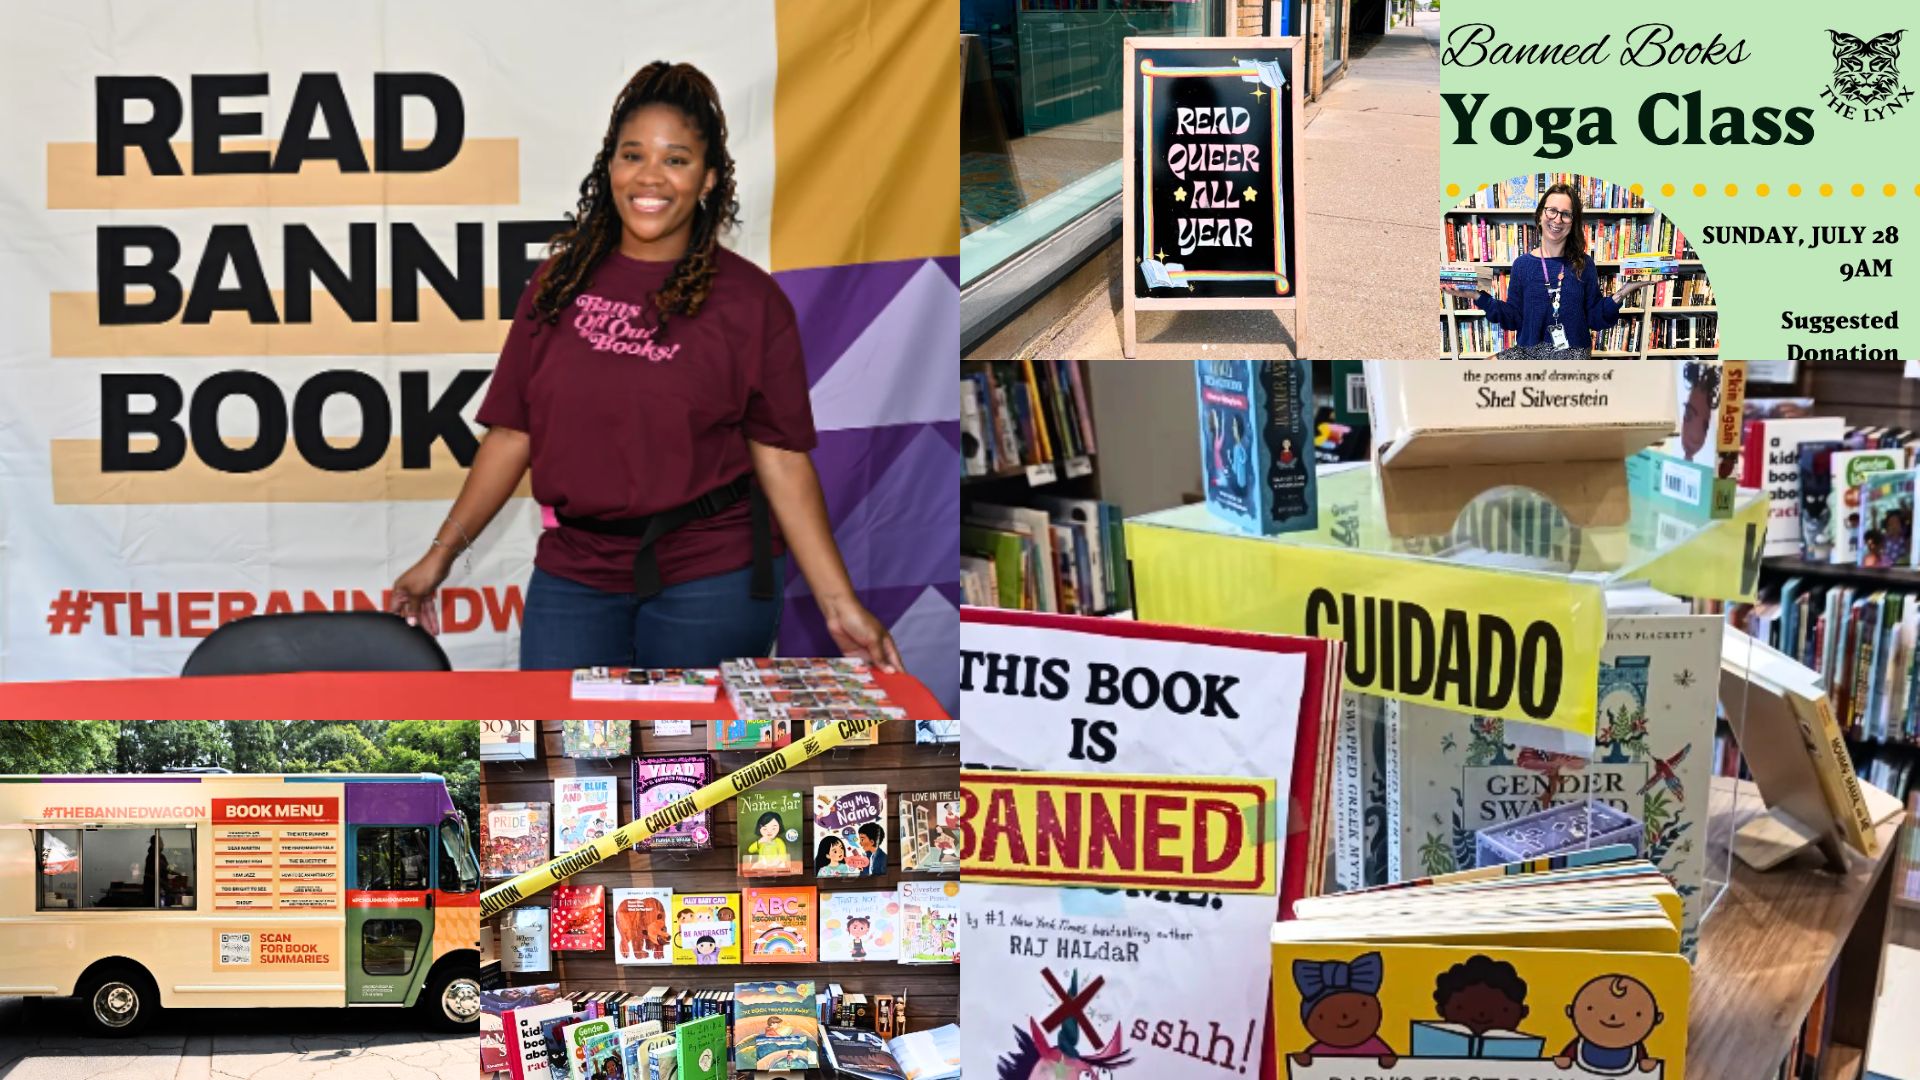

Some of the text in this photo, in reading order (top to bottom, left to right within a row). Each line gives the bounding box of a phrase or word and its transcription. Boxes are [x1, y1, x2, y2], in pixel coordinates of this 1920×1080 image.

[1441, 23, 1752, 67] Banned Books
[1820, 85, 1915, 122] THE LYNX
[95, 71, 466, 176] READ
[1175, 107, 1251, 135] READ
[1440, 90, 1815, 159] Yoga Class
[1167, 143, 1260, 179] QUEER
[1190, 180, 1240, 209] ALL
[1177, 218, 1253, 255] YEAR
[1702, 226, 1899, 249] SUNDAY, JULY 28
[97, 220, 573, 326] BANNE
[1840, 259, 1893, 283] 9AM
[1781, 311, 1899, 333] Suggested
[589, 333, 681, 361] Books!
[1787, 344, 1898, 360] Donation
[1464, 369, 1615, 383] the poems and drawings of
[1476, 386, 1609, 409] Shel Silverstein
[1722, 369, 1742, 445] Skin Again
[100, 369, 496, 473] BOOK
[1770, 437, 1780, 447] a
[1635, 631, 1693, 640] PLACKETT
[1305, 587, 1563, 720] CUIDADO
[960, 650, 1240, 719] THIS BOOK
[1068, 718, 1118, 763] IS
[649, 763, 695, 777] VLAD
[585, 782, 608, 791] BLUE
[1486, 772, 1625, 796] GENDER
[562, 793, 582, 802] AND
[741, 797, 800, 813] Name Jar
[836, 794, 871, 811] Say My
[911, 793, 928, 801] LOVE
[930, 792, 938, 800] IN
[939, 791, 952, 800] THE
[42, 805, 206, 818] #THEBANNEDWAGON
[226, 804, 323, 817] BOOK MENU
[493, 815, 527, 828] PRIDE
[550, 845, 602, 880] CUIDADO
[645, 796, 699, 834] CAUTION
[732, 752, 788, 792] CUIDADO
[837, 806, 877, 825] Name
[1347, 784, 1359, 839] GREEK
[752, 896, 798, 916] ABC
[260, 933, 292, 943] SCAN
[985, 909, 1006, 927] #1
[1010, 914, 1033, 927] New
[1036, 916, 1056, 931] York
[1058, 918, 1087, 935] Times
[1092, 923, 1151, 944] bestselling
[1156, 926, 1194, 941] author
[260, 944, 318, 953] FOR BOOK
[260, 954, 330, 964] SUMMARIES
[1010, 935, 1140, 962] RAJ HALdaR
[520, 1019, 528, 1027] a
[579, 1024, 604, 1036] Gender
[1130, 1018, 1256, 1075] sshh!
